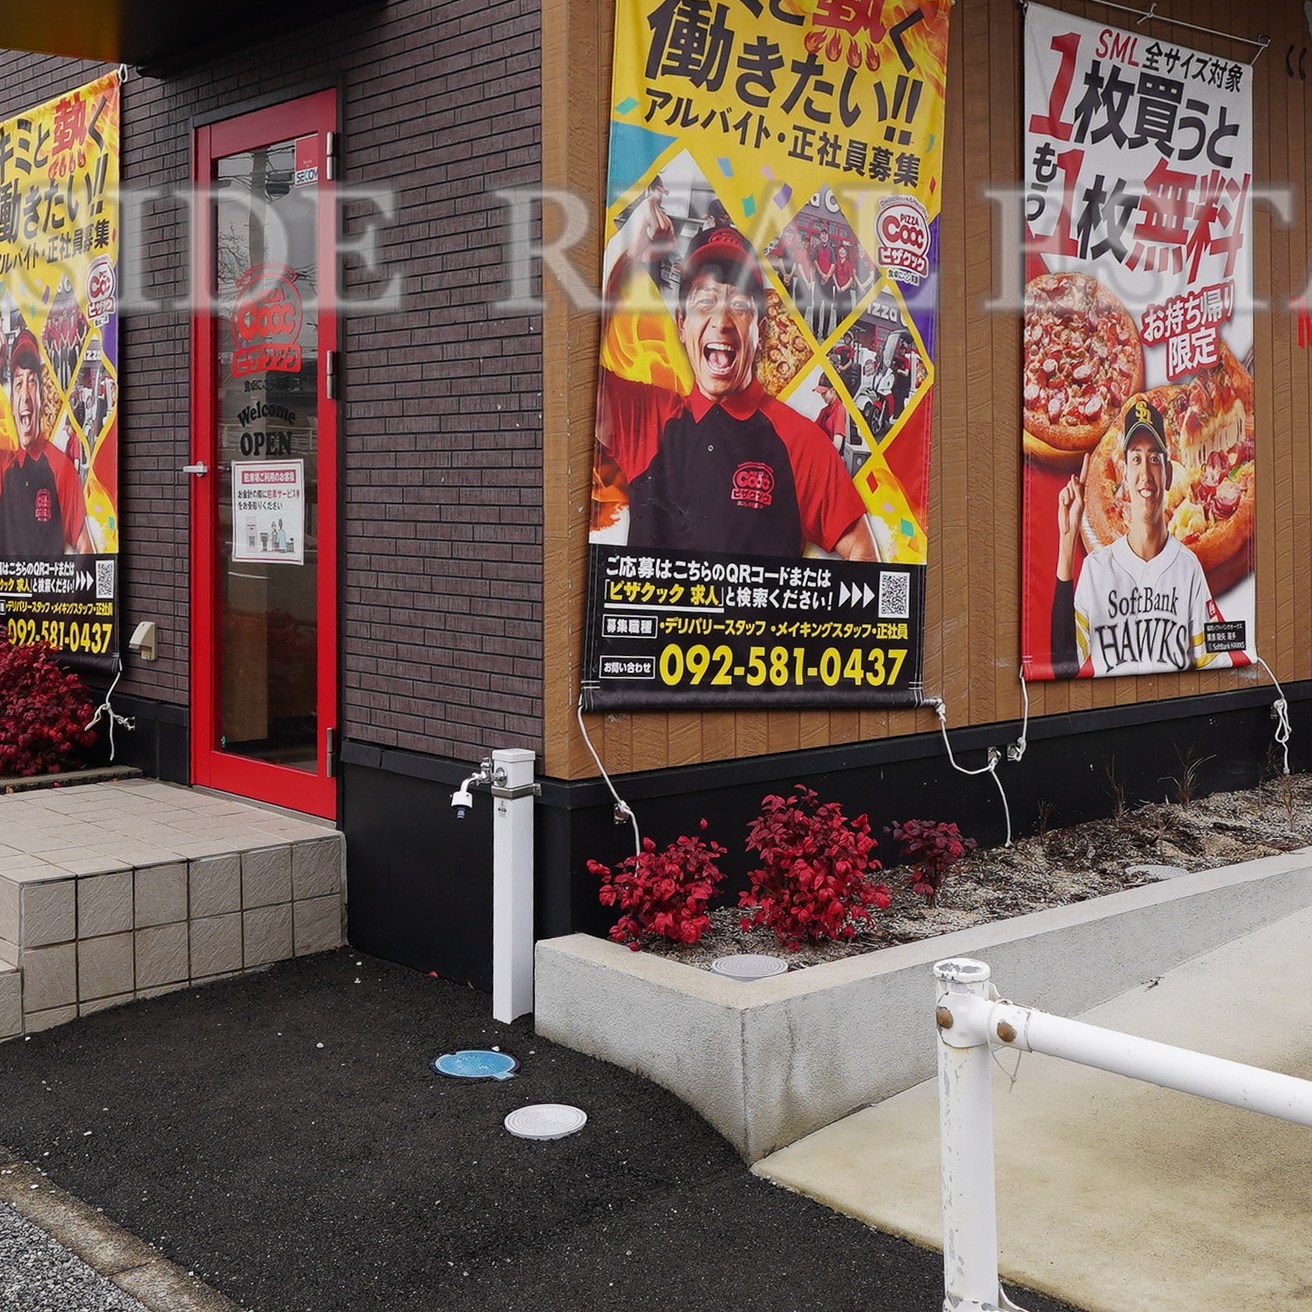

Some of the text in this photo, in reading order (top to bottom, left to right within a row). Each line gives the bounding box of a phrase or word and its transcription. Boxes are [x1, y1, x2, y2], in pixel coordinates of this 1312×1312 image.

[1094, 28, 1244, 93] SML 全サイズ対象
[1028, 31, 1240, 169] 1枚買うと
[644, 87, 922, 190] アルバイト・正社員募集
[880, 247, 926, 272] ピザクック
[1143, 284, 1236, 344] お持ち帰り
[1168, 328, 1218, 378] 限定
[238, 400, 296, 428] Welcome
[239, 431, 293, 457] OPEN
[605, 556, 831, 587] ご応募はこちらのQRコードまたは
[1108, 586, 1179, 619] SoftBank
[606, 618, 653, 635] 募集職種
[1095, 618, 1188, 672] HAWKS
[603, 661, 651, 675] お問い合わせ
[659, 643, 908, 687] 092-581-0437
